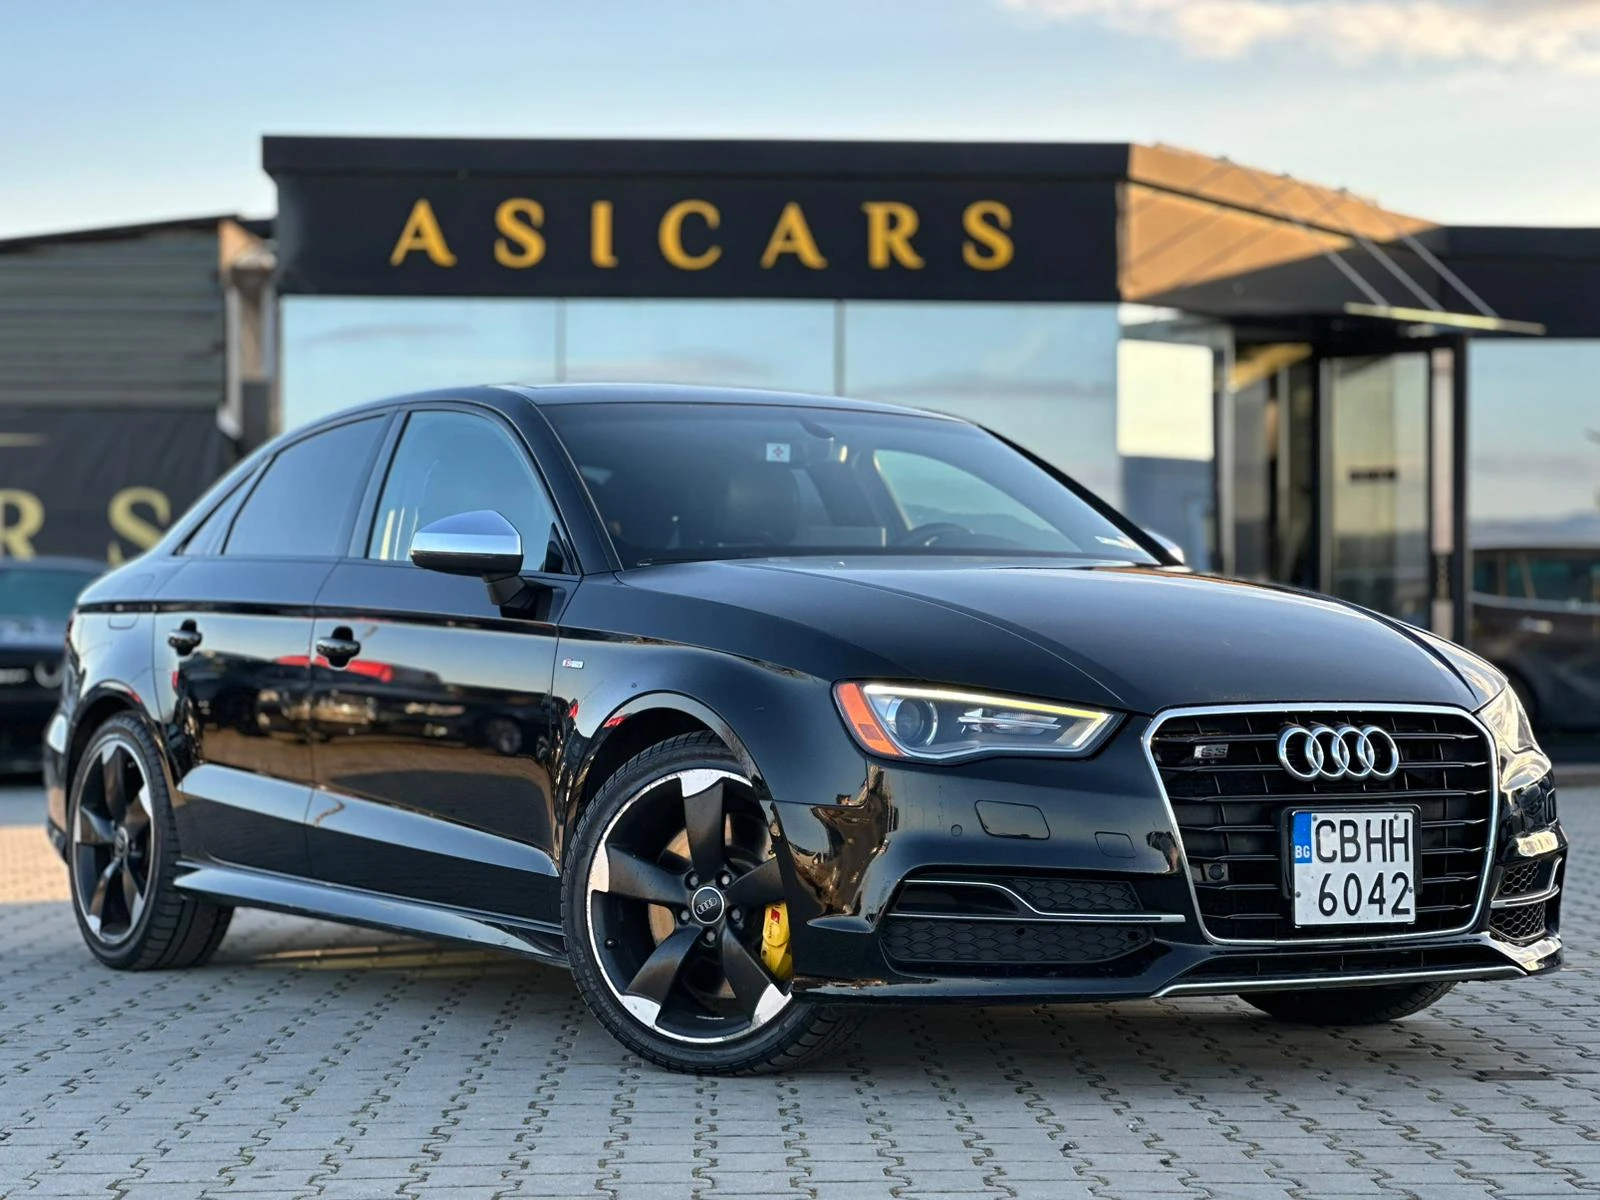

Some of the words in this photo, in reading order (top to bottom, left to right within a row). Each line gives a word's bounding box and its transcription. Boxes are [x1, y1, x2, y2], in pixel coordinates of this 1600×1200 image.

[390, 198, 1015, 270] ASICARS
[1295, 845, 1311, 859] BG
[1315, 818, 1409, 863] CBHH
[1318, 871, 1411, 916] 6042
